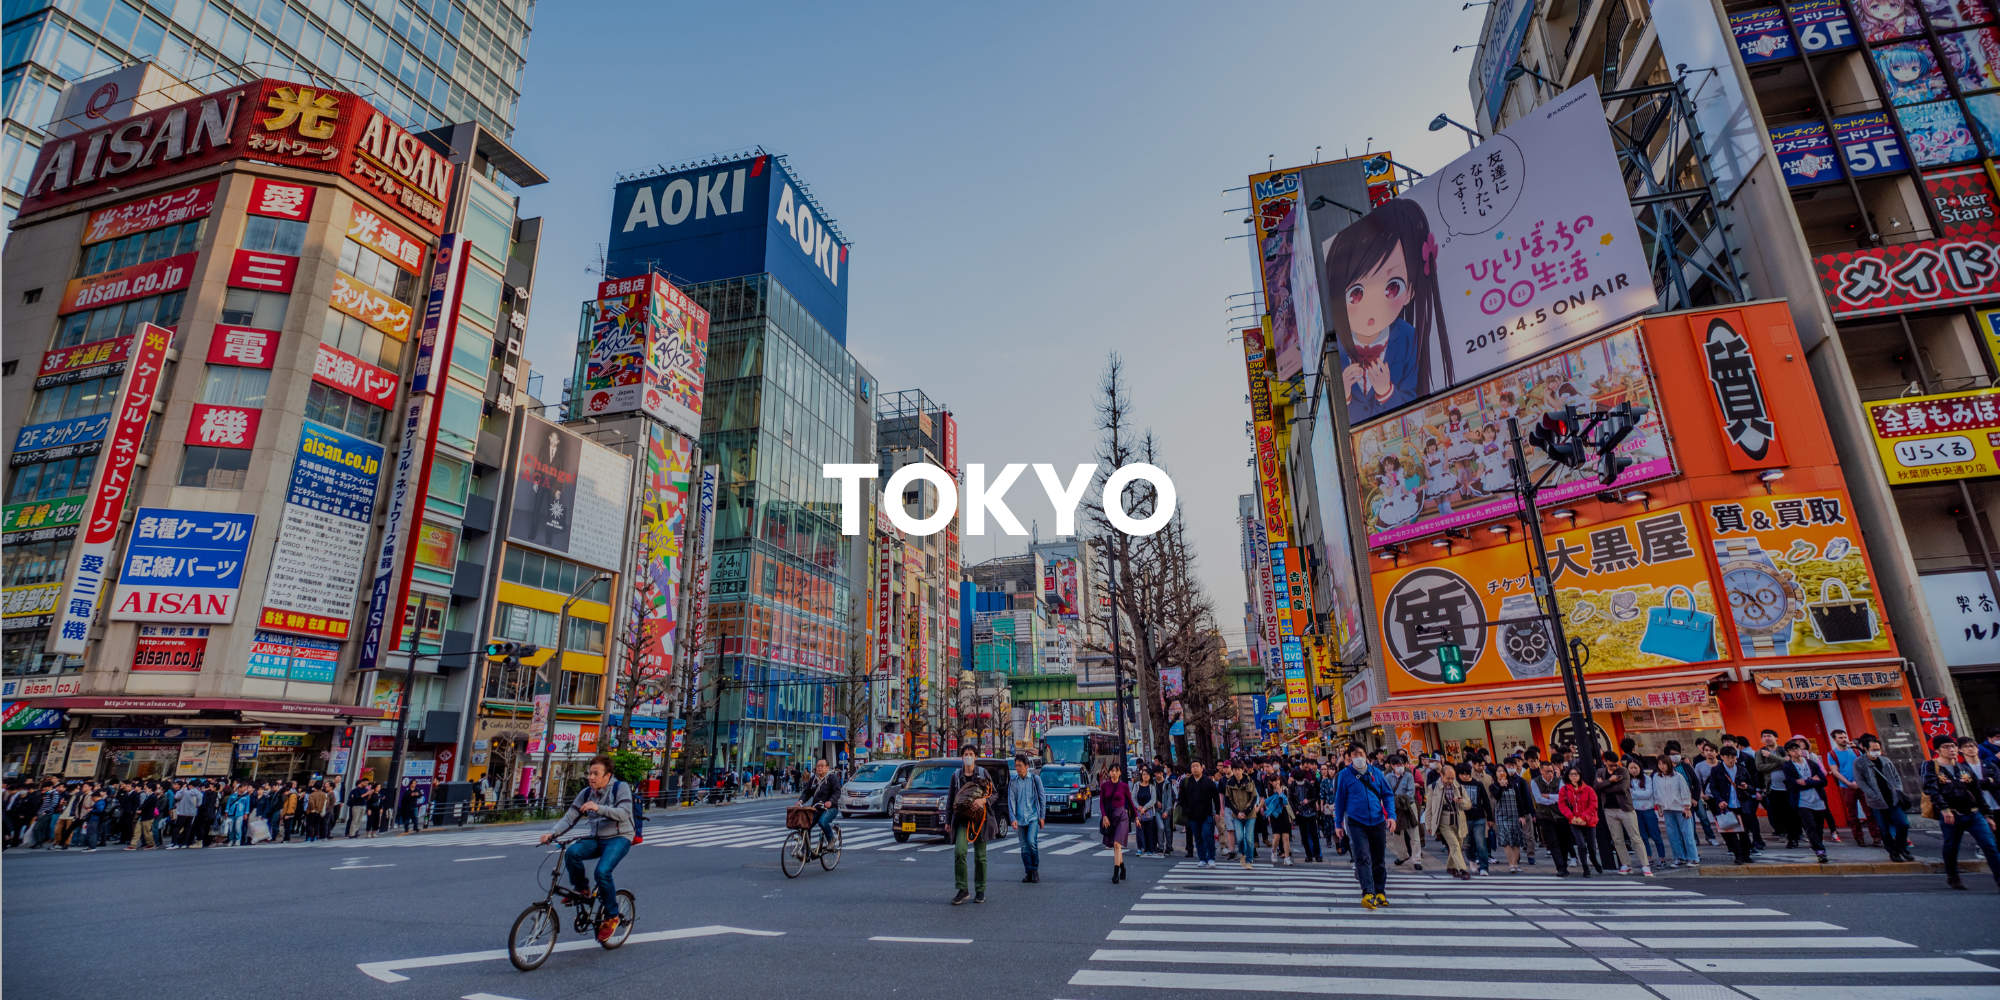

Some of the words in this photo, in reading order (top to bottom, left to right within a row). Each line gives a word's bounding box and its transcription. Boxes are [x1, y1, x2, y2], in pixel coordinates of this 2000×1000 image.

[1740, 34, 1789, 50] AMENITY
[1748, 42, 1788, 54] DREAM
[1800, 19, 1851, 50] 6F
[263, 86, 340, 140] 光
[1552, 92, 1587, 116] KADOKAWA
[28, 90, 246, 198] AISAN
[248, 134, 339, 161] ネットワーク
[359, 111, 453, 204] AISAN
[1845, 139, 1900, 172] 5F
[1487, 150, 1510, 195] 友達に
[1782, 153, 1834, 170] AMENITY
[1790, 161, 1832, 175] DREAM
[260, 184, 305, 217] 愛
[622, 168, 746, 233] AOKI
[1470, 163, 1493, 217] なりたい
[1940, 206, 1994, 223] Stars
[349, 210, 421, 268] 光通信
[775, 182, 839, 287] AOKI
[1465, 215, 1594, 284] ひとりぼっちの
[75, 265, 184, 308] aisan.co.jp
[241, 255, 286, 287] 三
[605, 278, 646, 297] 免税店
[332, 277, 411, 332] ネットワーク
[1466, 308, 1548, 354] 2019.4.5
[1553, 290, 1586, 316] ON
[1591, 273, 1630, 301] AIR
[416, 272, 447, 378] 愛三電機
[44, 353, 65, 371] 3F
[223, 329, 268, 364] 電
[313, 349, 396, 399] 配線パーツ
[19, 429, 41, 447] 2F
[41, 416, 110, 447] ネットワーク
[93, 332, 164, 533] 光・ケーブル・ネットワーク
[200, 408, 249, 445] 機
[303, 437, 379, 475] aisan.co.jp
[1621, 437, 1648, 453] cafe
[1901, 442, 1967, 461] りらくる
[521, 469, 552, 490] AGA
[523, 454, 578, 485] Change!
[1897, 463, 1988, 480] 秋葉原中央通り店
[380, 405, 421, 569] 各種ケーブル・ネットワーク機器
[702, 470, 714, 513] AKKY
[2, 509, 15, 527] F
[138, 516, 247, 542] 各種ケーブル
[1711, 496, 1847, 534] 質&買取
[1546, 511, 1695, 583] 大黒屋
[128, 555, 238, 580] 配線パーツ
[715, 569, 740, 578] OPEN
[61, 554, 104, 641] 愛三電機
[118, 591, 231, 616] AISAN
[1260, 566, 1274, 615] Tax-free
[1289, 570, 1305, 611] 吉野家
[1956, 593, 1994, 614] 喫茶
[142, 626, 156, 636] 各社
[161, 627, 176, 636] 特約
[179, 627, 194, 637] 在庫
[264, 611, 284, 625] 各社
[287, 614, 306, 628] 特約
[308, 617, 326, 631] 在庫
[328, 620, 347, 634] 直販
[364, 579, 387, 661] AISAN
[1266, 615, 1277, 647] Shop
[1284, 653, 1302, 661] DVD
[1786, 671, 1901, 690] 1階にて高価買取中
[104, 700, 186, 709] http://www.aisan.co.jp
[282, 704, 341, 714] http://www.aisan.co.jp
[1647, 690, 1706, 707] 無料査定
[1921, 700, 1942, 714] 4F
[139, 729, 160, 737] 1949
[1373, 711, 1411, 724] 高価買取
